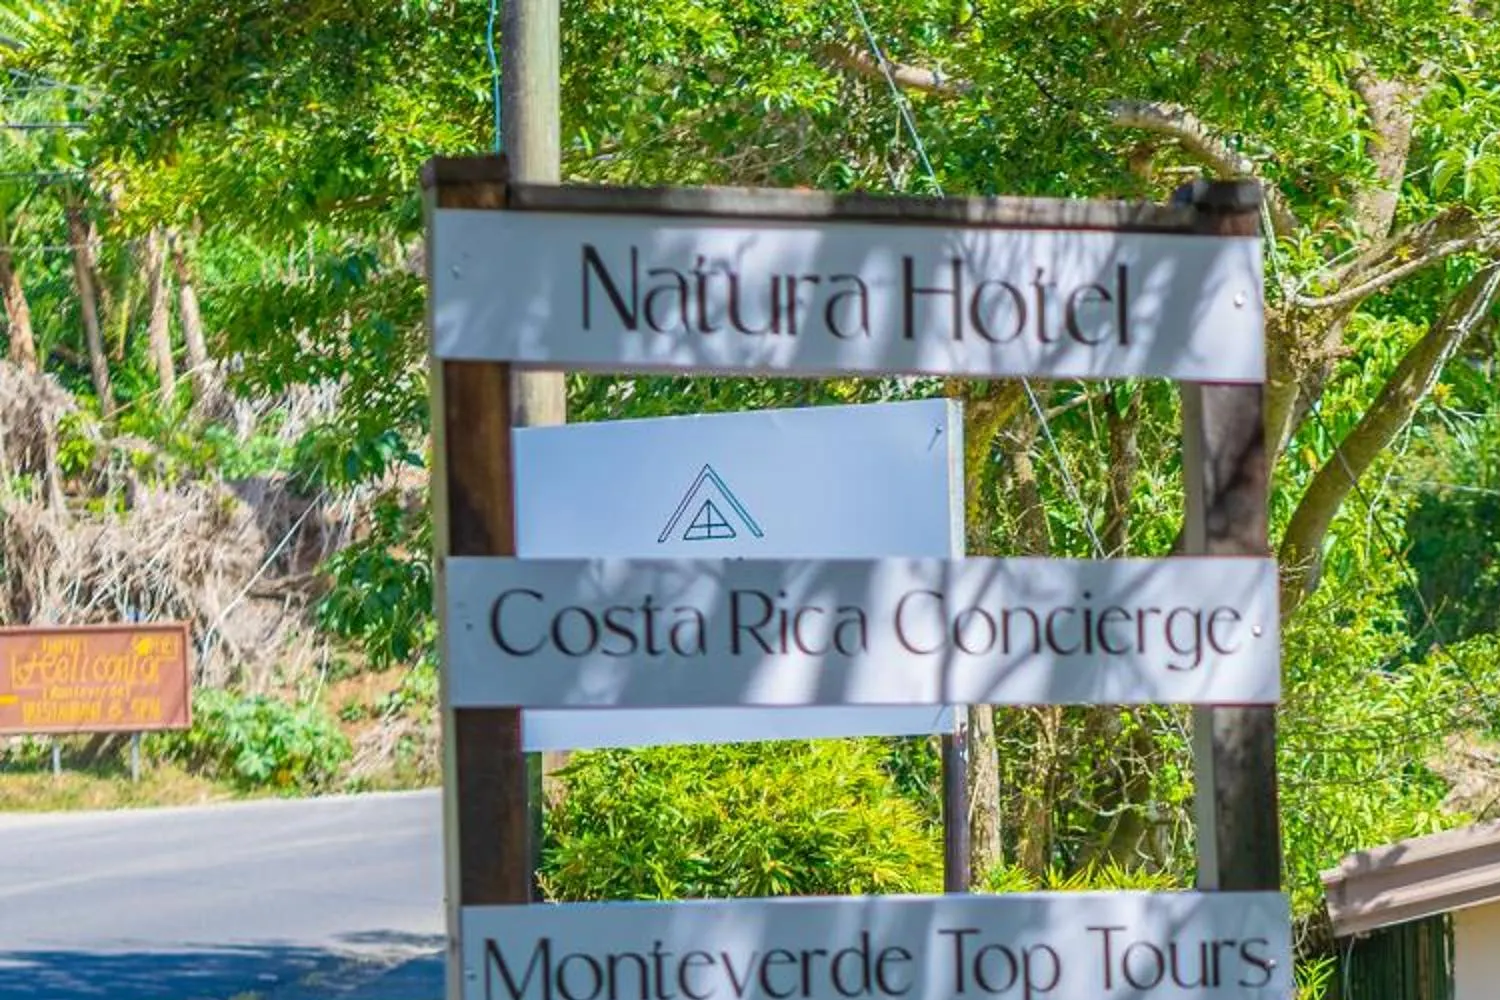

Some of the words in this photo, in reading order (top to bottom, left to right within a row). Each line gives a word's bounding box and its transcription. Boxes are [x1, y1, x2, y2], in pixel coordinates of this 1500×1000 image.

[580, 244, 871, 338] Natura
[903, 256, 1131, 346] Hotel
[489, 587, 707, 658] Costa
[729, 588, 869, 657] Rica
[893, 588, 1242, 671] Concierge
[1086, 923, 1274, 992] Tours
